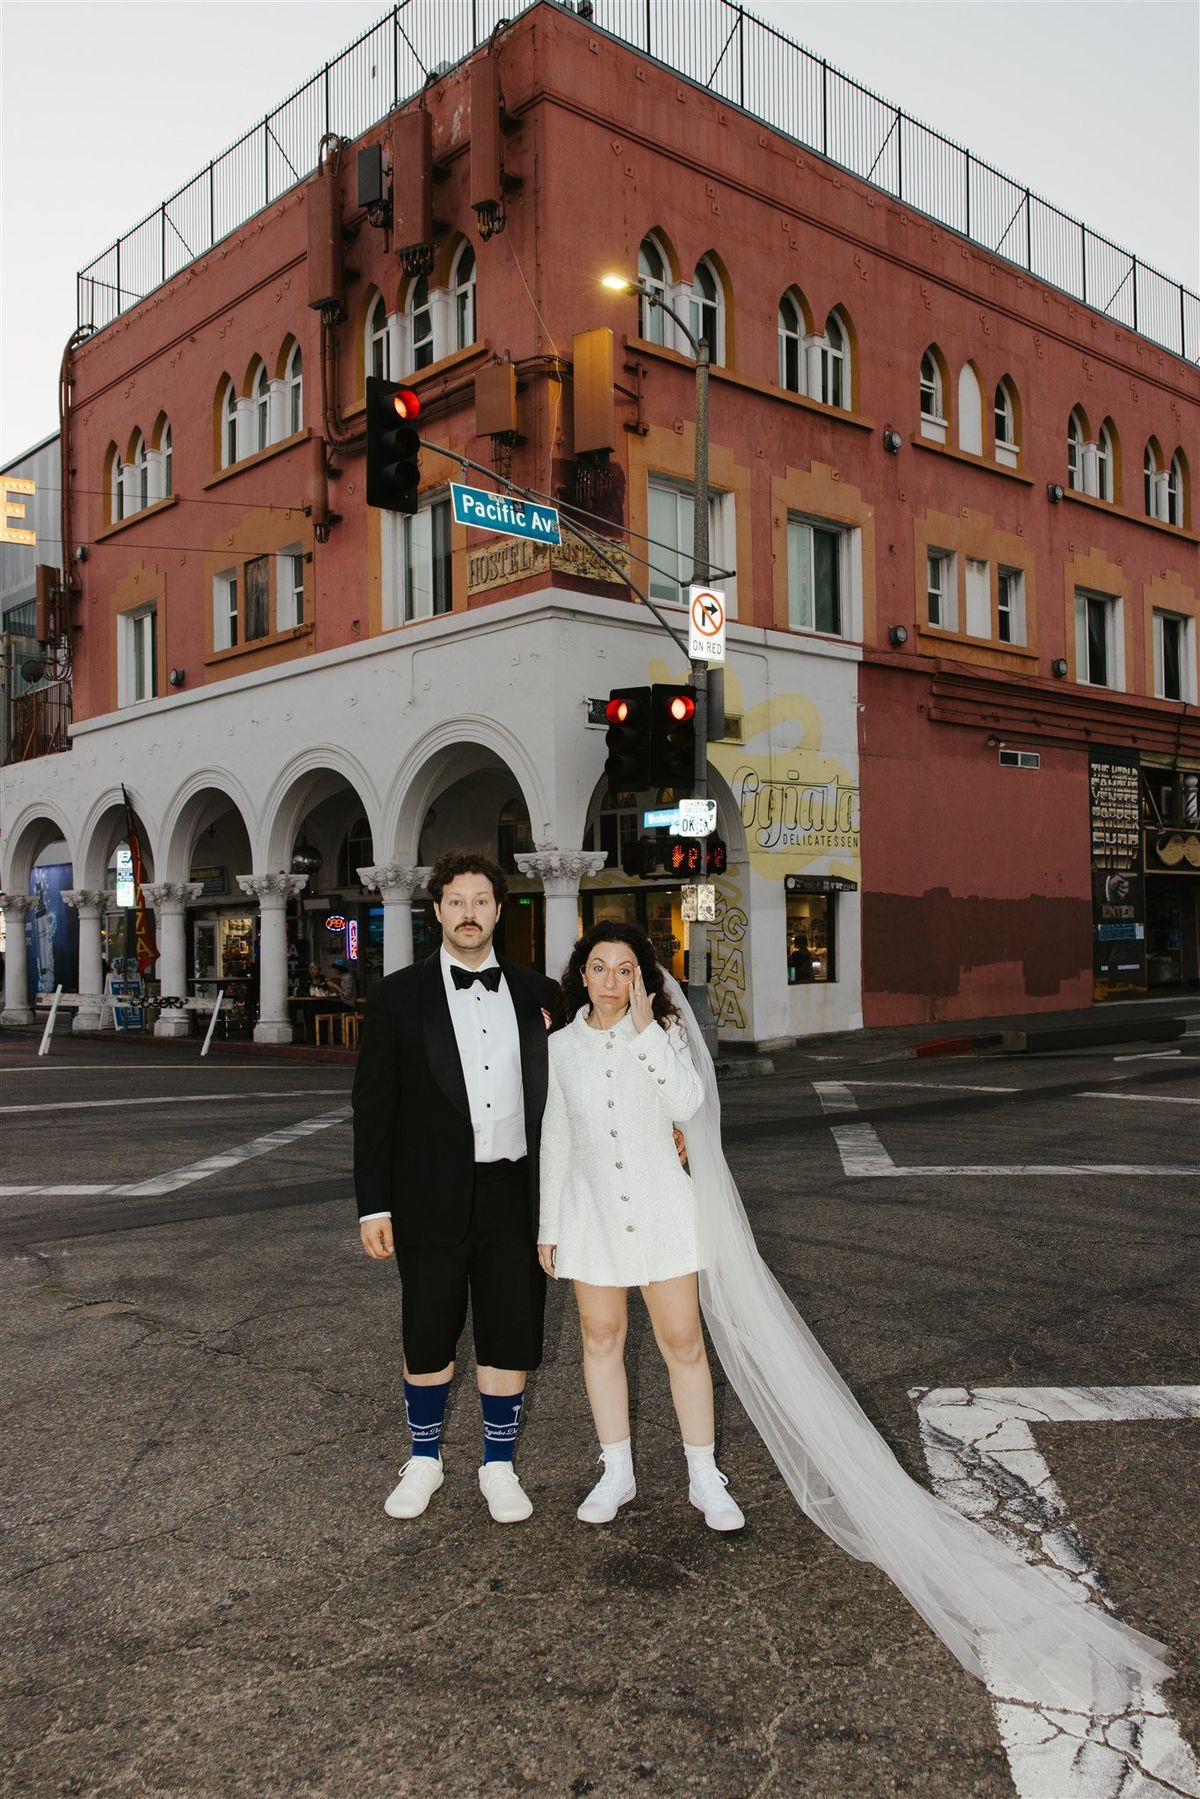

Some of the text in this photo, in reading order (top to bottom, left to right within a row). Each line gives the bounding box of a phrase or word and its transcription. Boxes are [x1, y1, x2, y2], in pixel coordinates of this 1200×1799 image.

[462, 493, 526, 527] Pacific
[468, 541, 534, 588] HOSTEL
[692, 639, 722, 655] ON RED
[682, 819, 695, 832] OK
[782, 833, 858, 848] DELICATESSEN
[1102, 905, 1135, 918] ENTER
[326, 918, 346, 929] OPEN
[350, 921, 358, 959] PIZZA
[287, 943, 300, 991] ATM
